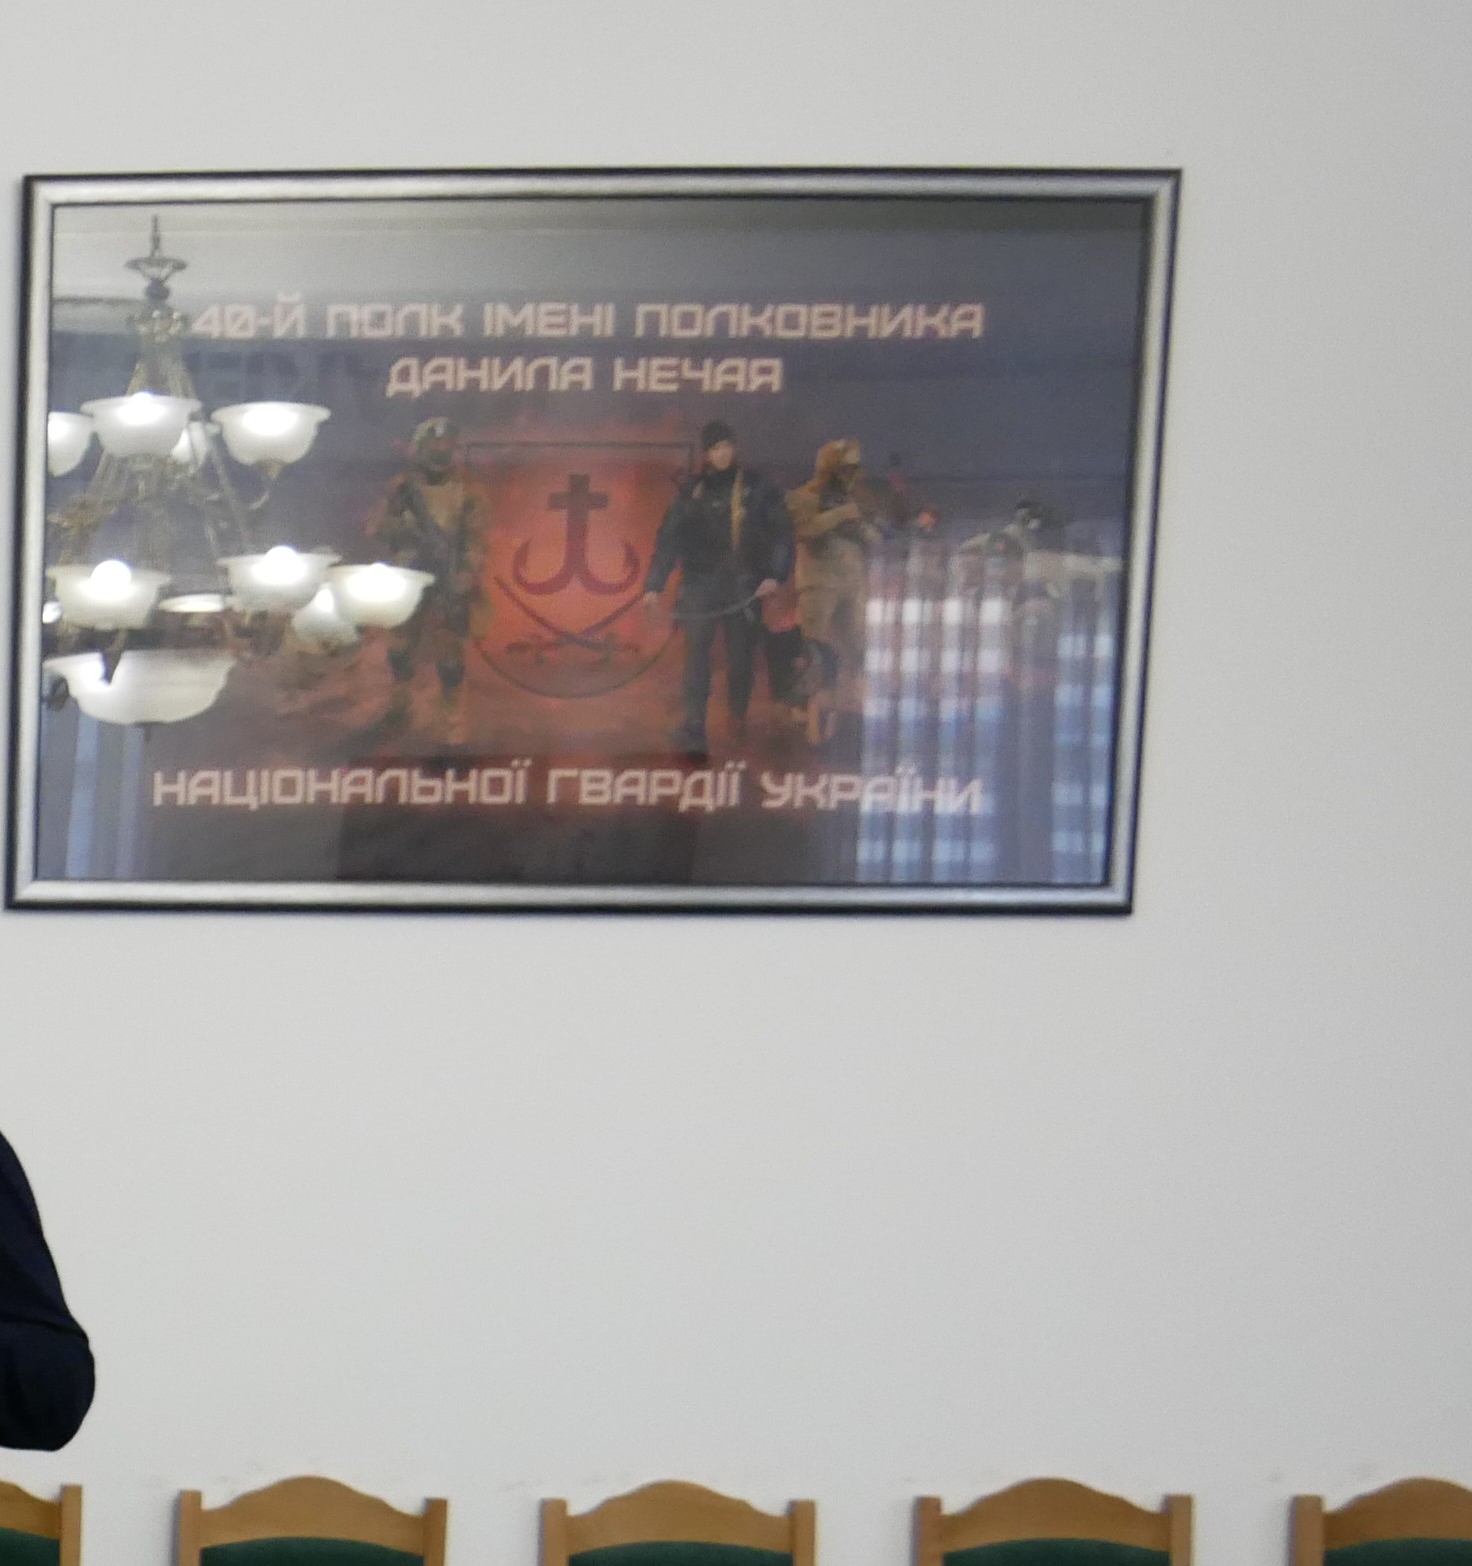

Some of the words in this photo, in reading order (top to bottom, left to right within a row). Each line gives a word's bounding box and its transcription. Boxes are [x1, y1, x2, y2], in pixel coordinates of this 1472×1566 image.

[190, 292, 306, 339] 40-Й
[326, 303, 464, 339] ПОЛК
[483, 303, 616, 338] ІМЕНІ
[635, 302, 984, 339] ПОЛКОВНИКА
[386, 356, 593, 398] ДАНИЛА
[613, 357, 783, 393] НЕЧАЯ
[154, 759, 531, 811] НАЦІОНАЛЬНОЇ
[547, 760, 747, 813] ГВАРДІЇ
[760, 764, 984, 815] УКРАЇНИ
